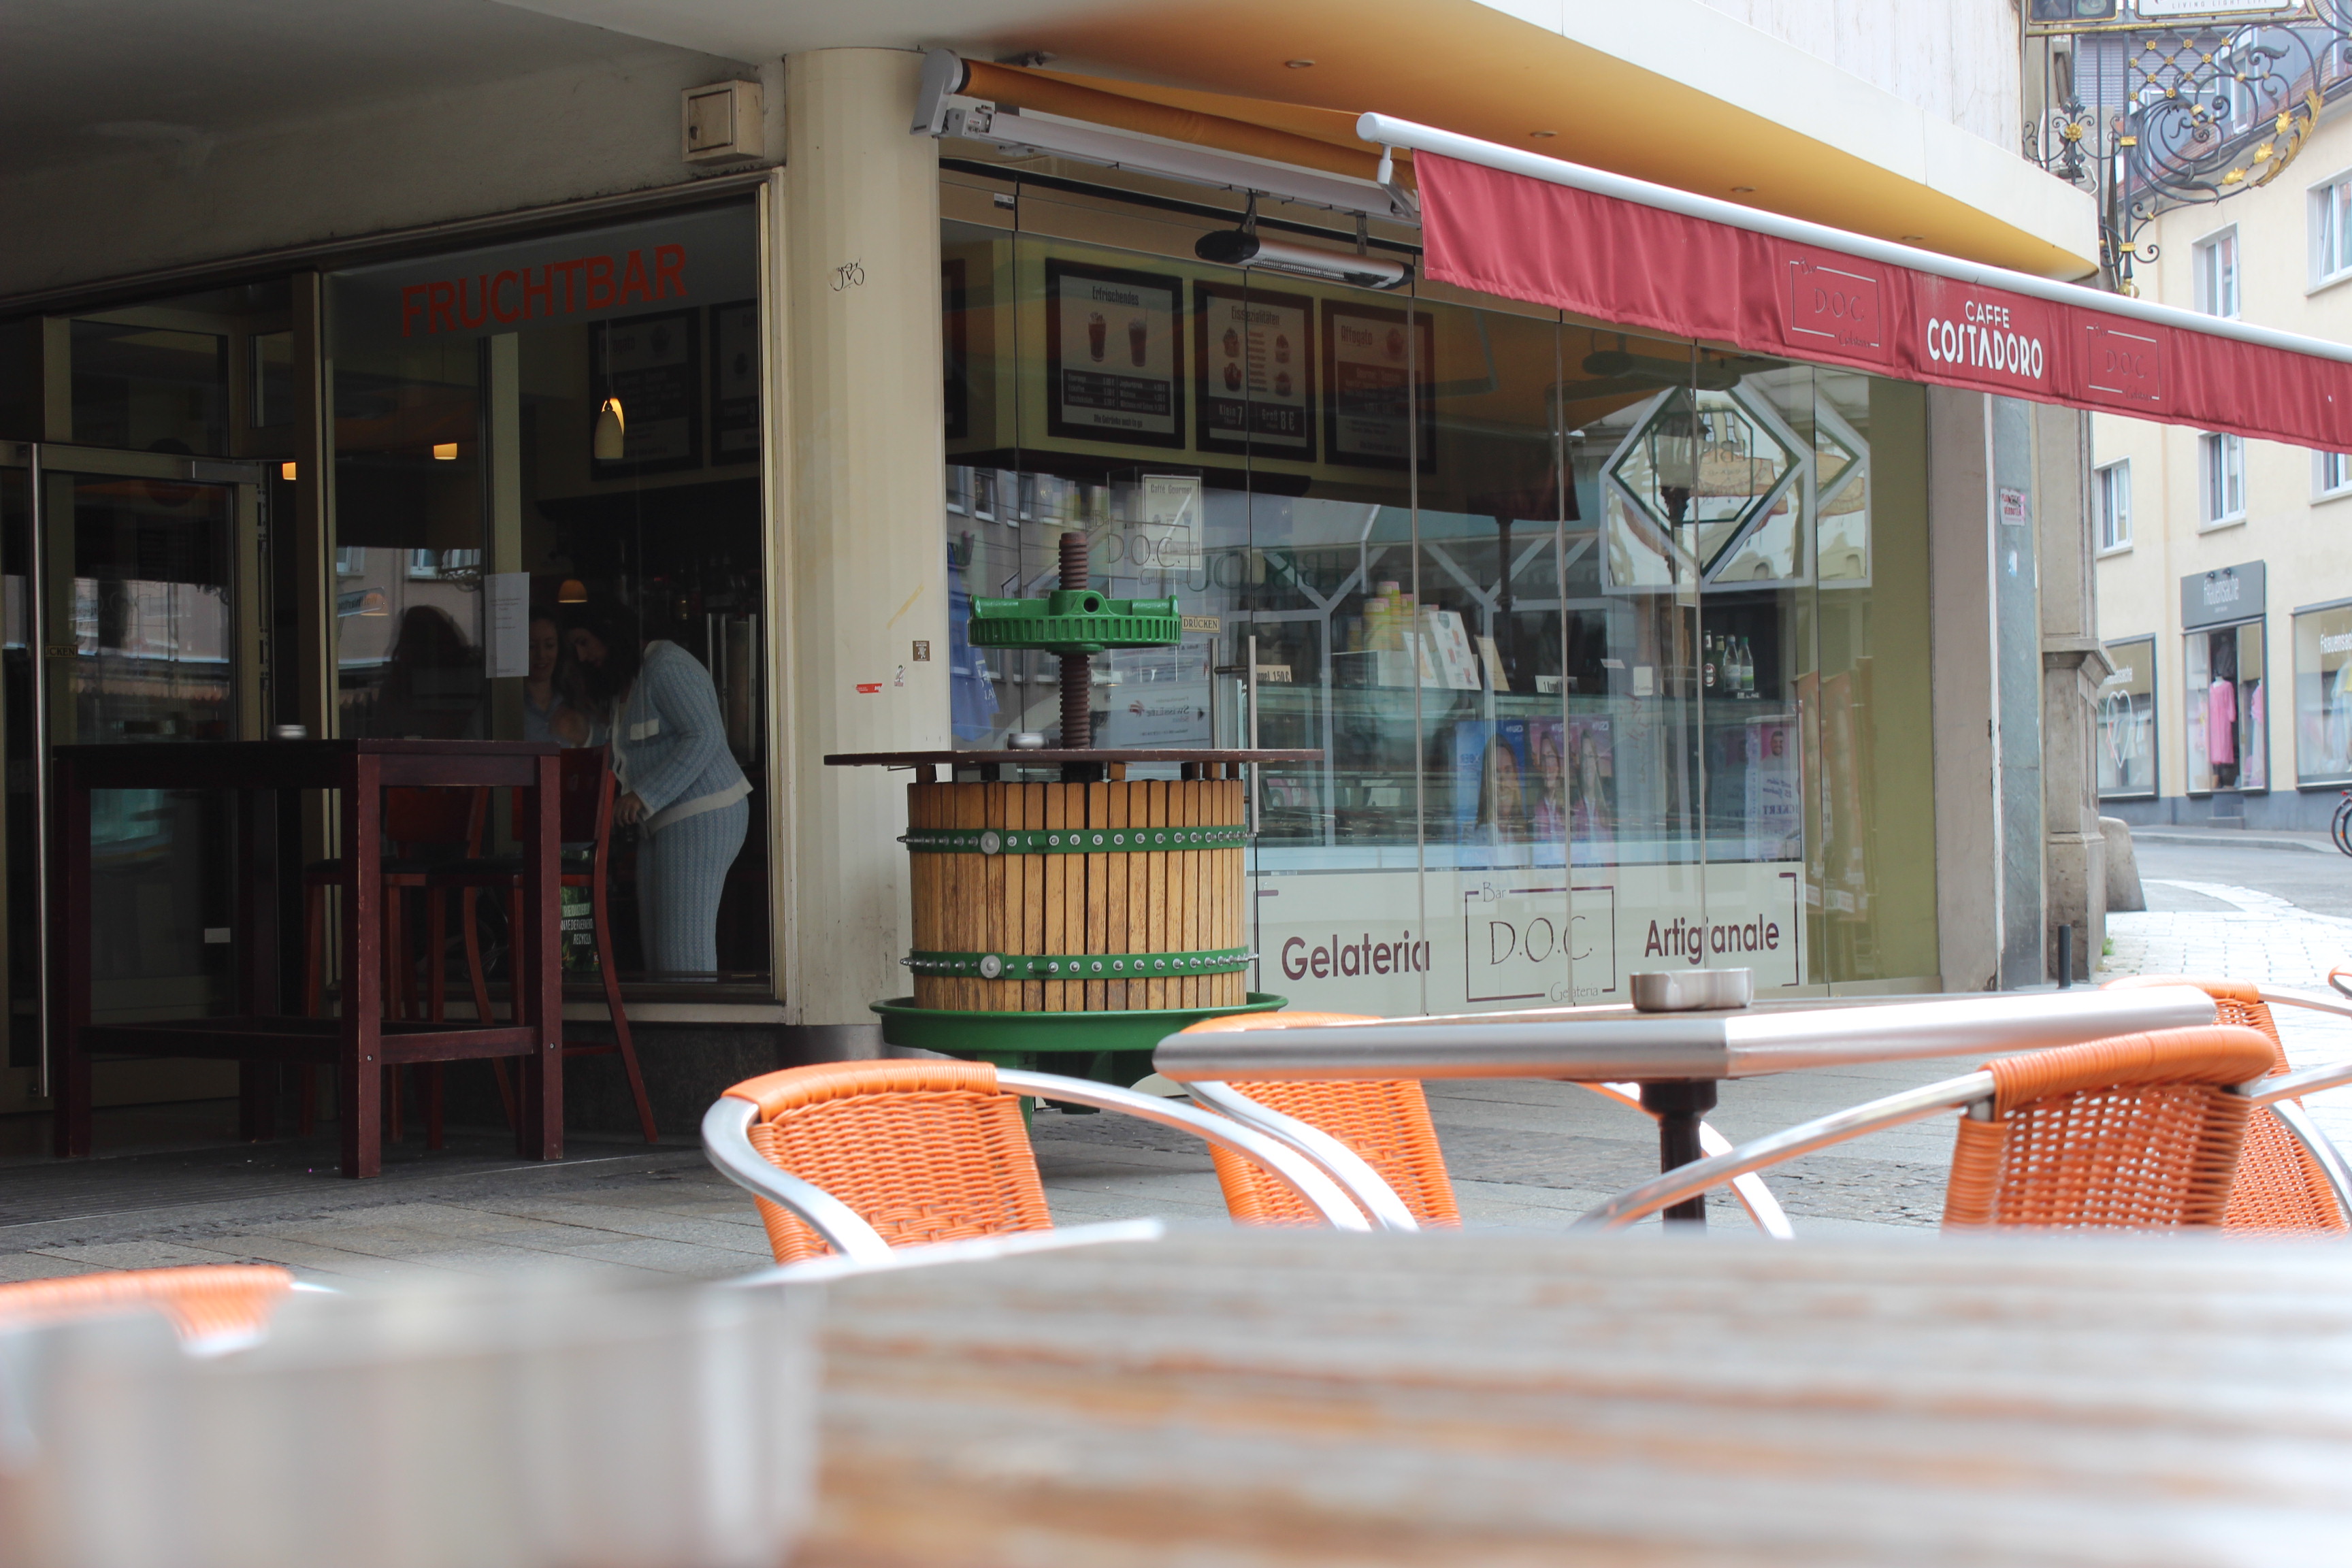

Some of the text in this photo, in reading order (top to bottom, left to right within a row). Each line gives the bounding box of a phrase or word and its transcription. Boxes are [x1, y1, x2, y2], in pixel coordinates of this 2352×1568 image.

[401, 243, 687, 338] FRUCHTBAR
[1092, 285, 1139, 306] Erfrischendes
[1231, 306, 1280, 325] Eissezialitäten
[1341, 325, 1373, 347] Affogato
[1927, 317, 2043, 380] COSTADORO
[1219, 404, 1236, 417] Klein
[1183, 616, 1218, 629] DRÜCKEN
[1482, 881, 1507, 903] Bar
[1488, 915, 1593, 966] D.O.C.
[1281, 930, 1431, 981] Gelateria
